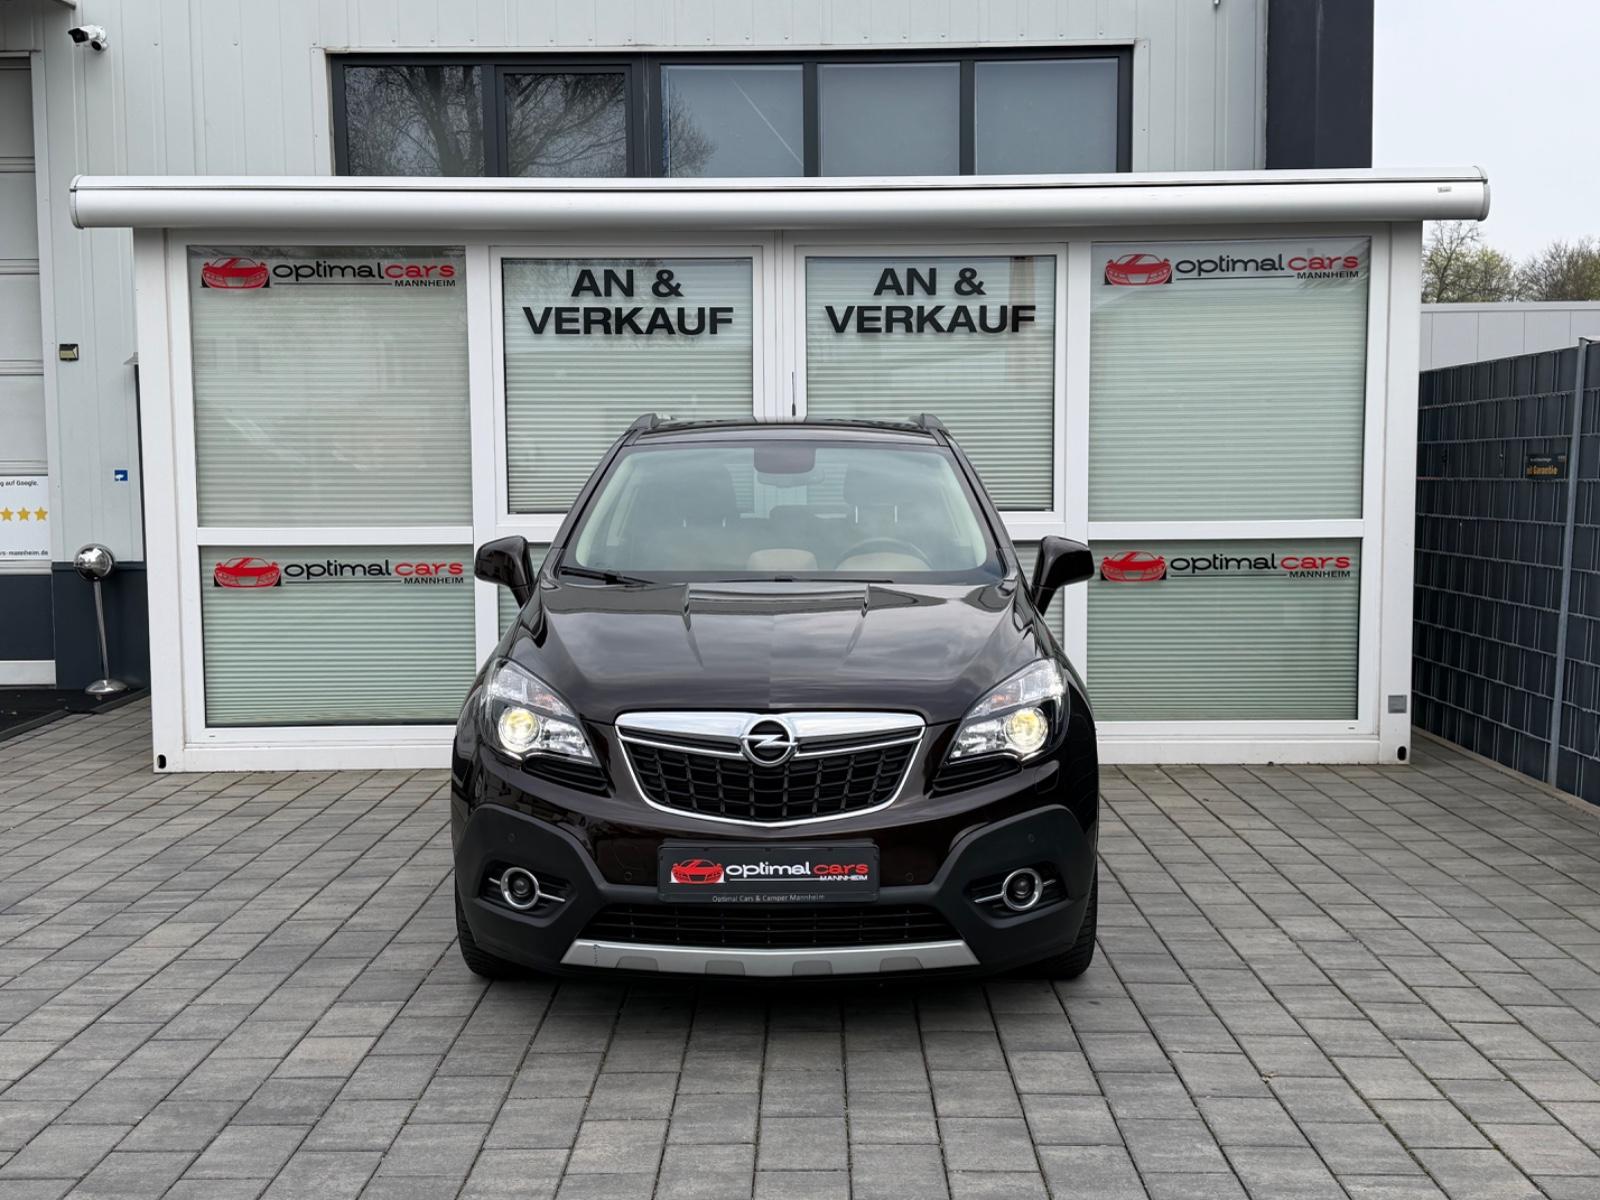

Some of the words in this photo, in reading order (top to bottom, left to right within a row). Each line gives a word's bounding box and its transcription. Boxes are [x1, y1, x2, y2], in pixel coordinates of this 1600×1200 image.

[272, 261, 384, 281] optimal
[384, 264, 455, 278] cars
[1175, 254, 1284, 276] optimal
[1287, 255, 1358, 271] cars
[1297, 271, 1359, 279] MANNHEIM
[394, 279, 456, 287] MANNHEIM
[571, 269, 634, 297] AN
[651, 269, 684, 297] &
[873, 268, 937, 296] AN
[954, 267, 987, 296] &
[522, 307, 734, 335] VERKAUF
[825, 305, 1036, 333] VERKAUF
[284, 560, 392, 580] optimal
[394, 562, 463, 577] cars
[1170, 553, 1277, 573] optimal
[1280, 556, 1350, 570] cars
[404, 577, 463, 585] MANNHEIM
[725, 861, 811, 879] optimal
[814, 863, 869, 875] cars
[712, 895, 737, 903] Optimal
[762, 894, 787, 902] Camper
[790, 893, 825, 901] Mannheim
